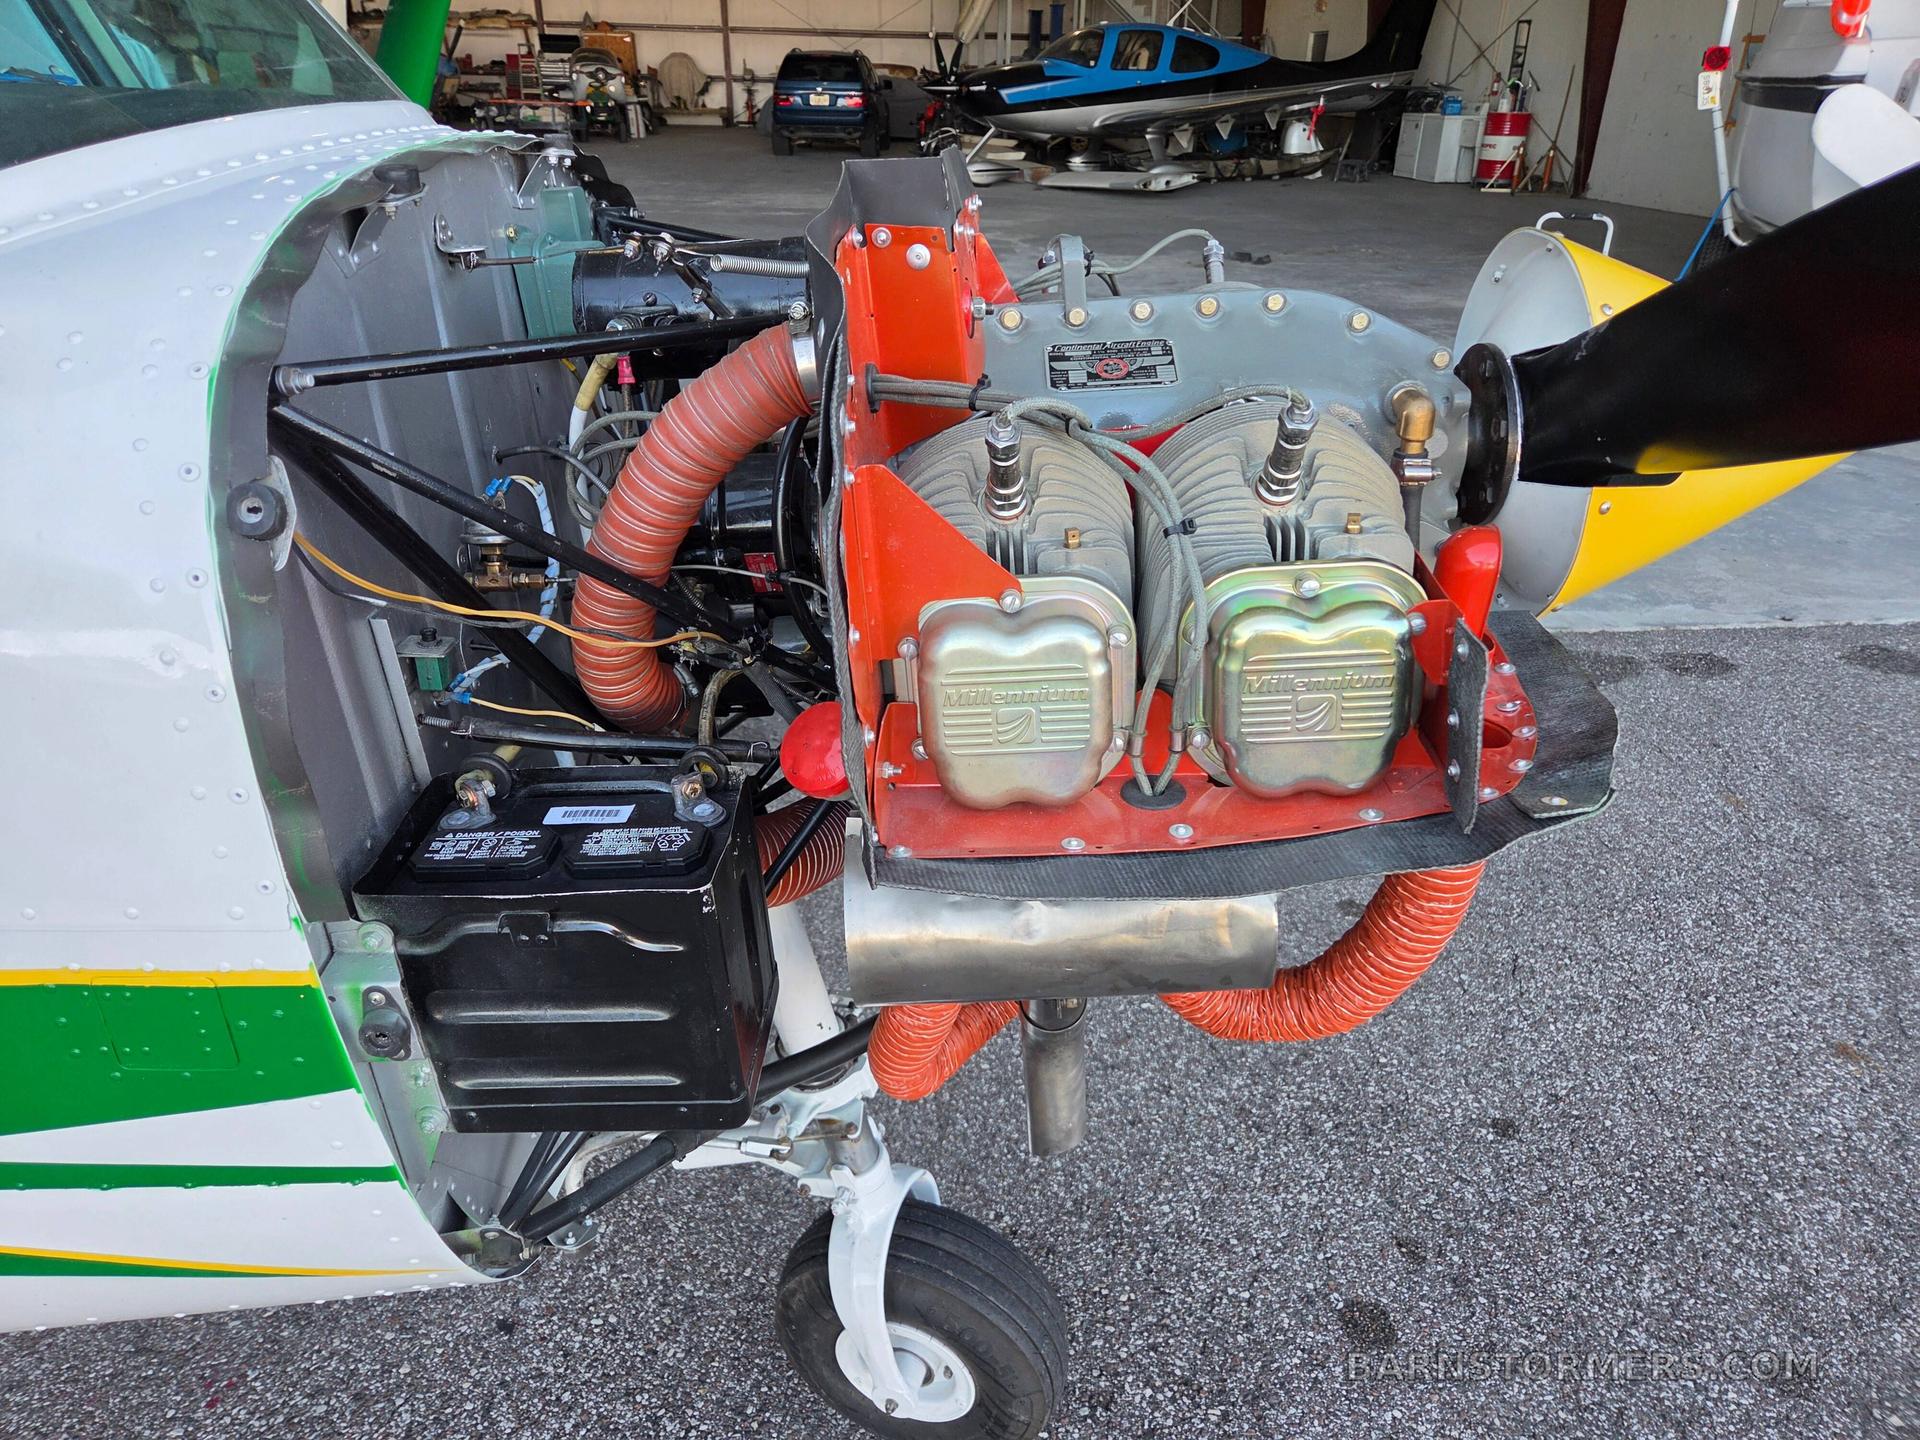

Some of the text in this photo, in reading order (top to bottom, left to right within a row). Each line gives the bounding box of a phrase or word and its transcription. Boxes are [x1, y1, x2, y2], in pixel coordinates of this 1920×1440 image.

[1054, 343, 1103, 352] Continental
[1102, 341, 1136, 350] Aircraft
[1136, 340, 1165, 348] Engine
[1244, 671, 1395, 694] Millennium
[943, 685, 1089, 708] Millennium
